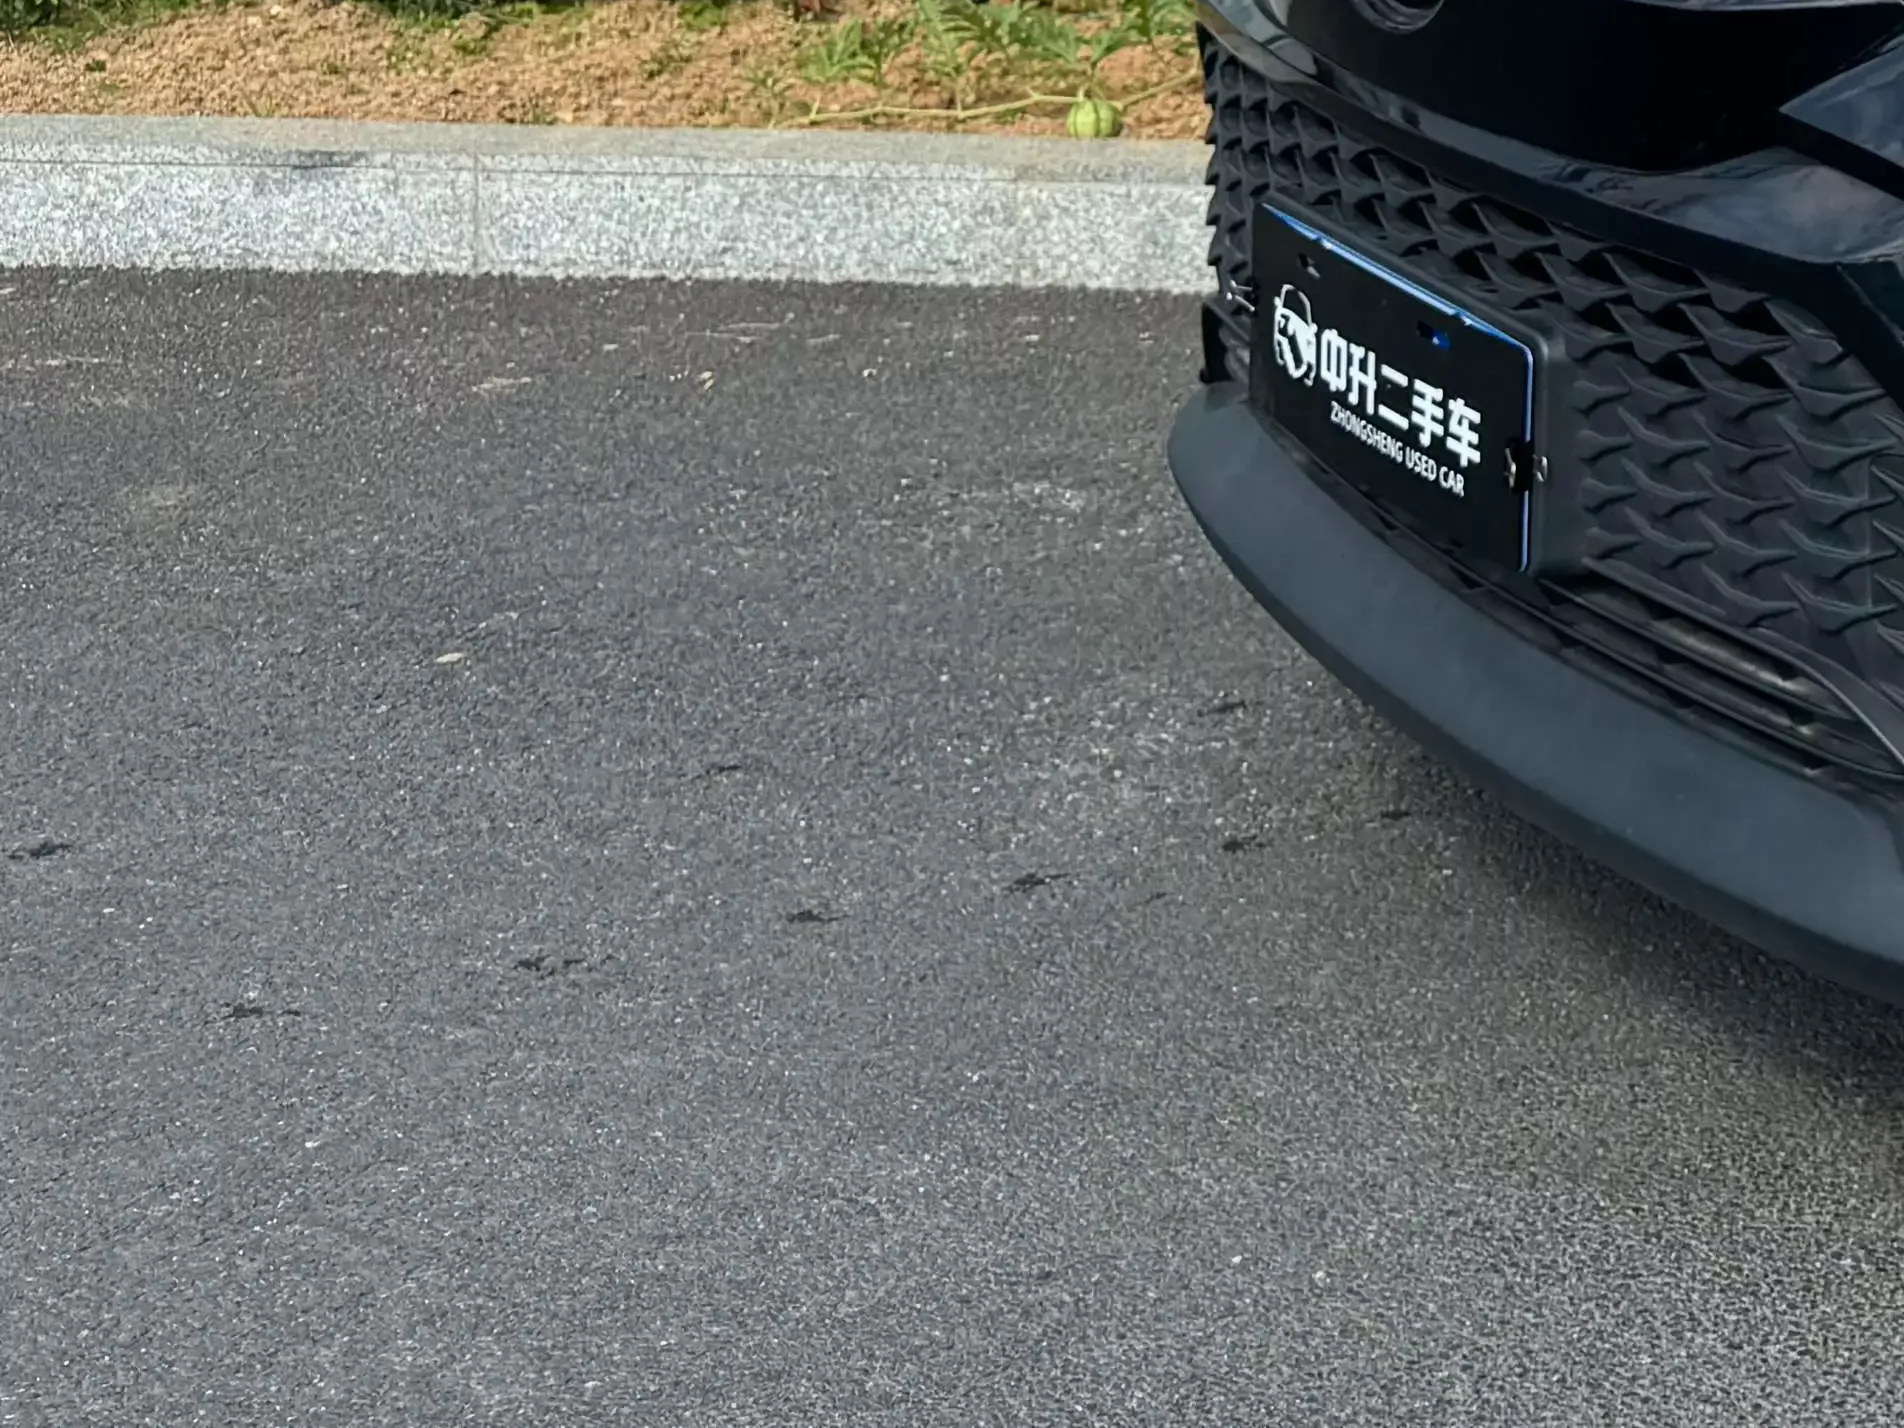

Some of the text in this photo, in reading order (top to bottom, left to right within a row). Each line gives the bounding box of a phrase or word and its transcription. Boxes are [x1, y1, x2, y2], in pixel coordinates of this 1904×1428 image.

[1320, 328, 1482, 468] 中升二手车
[1330, 400, 1465, 497] ZHONGSHENG USED CAR
